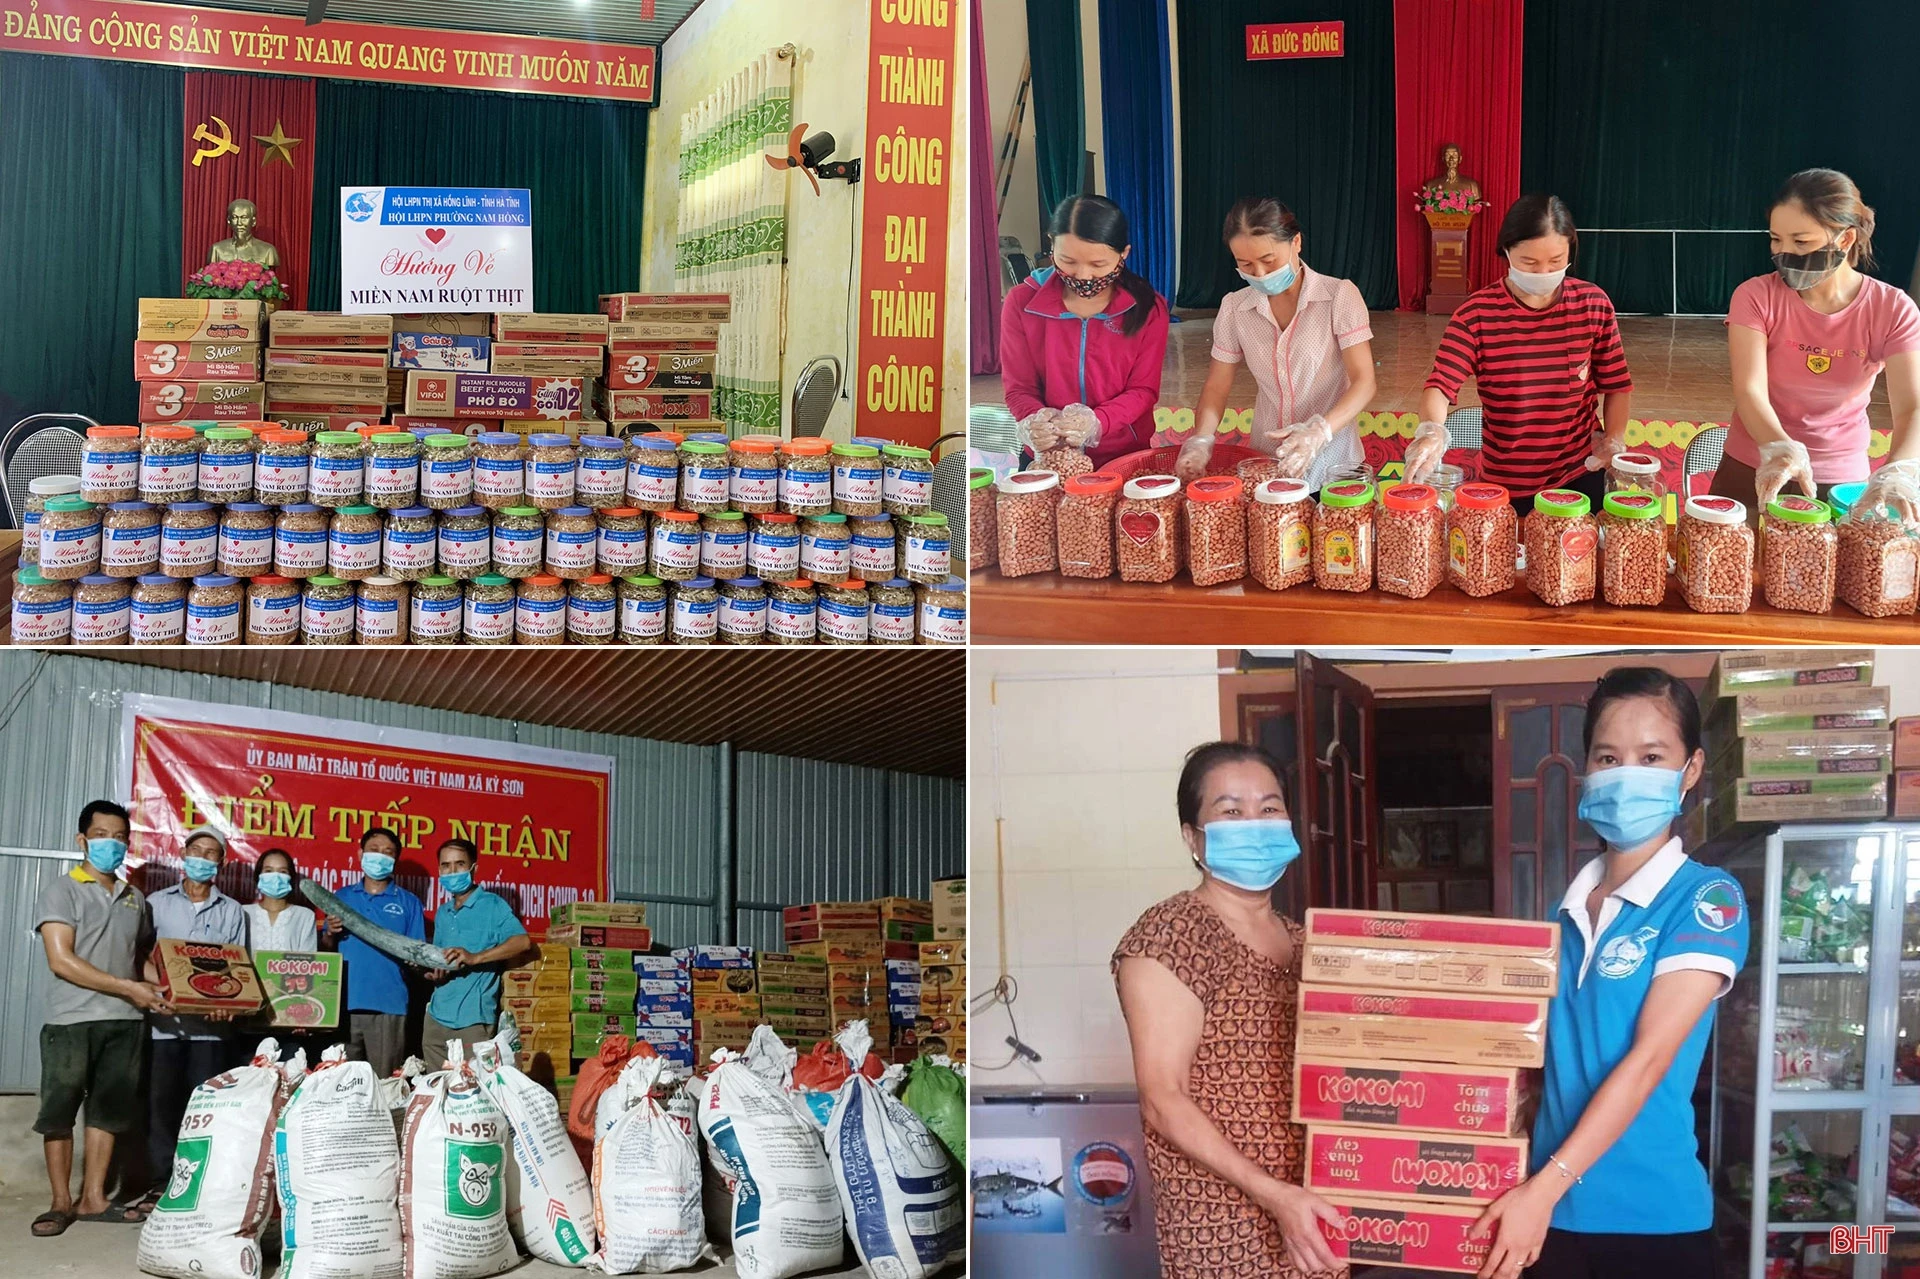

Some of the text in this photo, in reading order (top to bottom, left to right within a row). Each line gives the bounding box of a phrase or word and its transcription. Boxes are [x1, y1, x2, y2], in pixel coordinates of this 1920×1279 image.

[4, 0, 649, 88] ĐẢNG CỘNG SẢN VIỆT NAM QUANG VINH MUÔN NĂM
[1252, 25, 1339, 54] XÃ ĐỨC ĐỒNG
[879, 48, 945, 106] THÀNH
[874, 126, 942, 185] CÔNG
[392, 195, 403, 208] HỘI
[405, 197, 421, 206] LHPN
[388, 211, 406, 224] HỘI
[408, 213, 432, 222] LHPN
[475, 213, 496, 222] NAM
[884, 215, 927, 274] ĐẠI
[380, 248, 457, 287] Hướng
[350, 286, 524, 306] MIỀN NAM RUỘT THỊT
[870, 280, 935, 339] THÀNH
[149, 343, 178, 375] 3
[624, 355, 648, 384] 3
[867, 354, 934, 414] CÔNG
[156, 384, 186, 416] 3
[420, 391, 445, 400] VIFON
[468, 394, 518, 406] PHỞ BÒ
[651, 402, 701, 415] KOKOMI
[855, 493, 871, 501] NAM
[60, 556, 78, 565] NAM
[269, 625, 286, 633] NAM
[247, 742, 525, 796] ỦY BAN MẶT TRẬN TỔ QUỐC VIỆT NAM XÃ KỲ SƠN
[329, 796, 435, 849] TIẾP
[448, 814, 572, 868] NHẬN
[520, 882, 544, 926] DỊCH
[1362, 918, 1423, 938] KOKOMI
[173, 945, 241, 961] KOKOMI
[267, 959, 329, 976] KOKOMI
[1351, 995, 1411, 1015] KOKOMI
[336, 1078, 364, 1093] Cargill
[1318, 1075, 1425, 1109] KOKOMI
[1457, 1083, 1489, 1097] Tôm
[1454, 1100, 1490, 1113] chua
[450, 1122, 497, 1138] N-959
[1458, 1115, 1484, 1129] cay
[1334, 1137, 1359, 1149] cay
[1329, 1152, 1363, 1164] chua
[1392, 1157, 1499, 1190] KOKOMI
[648, 1227, 668, 1235] CÁCH
[1325, 1215, 1429, 1248] KOKOMI
[1461, 1224, 1491, 1238] Tm
